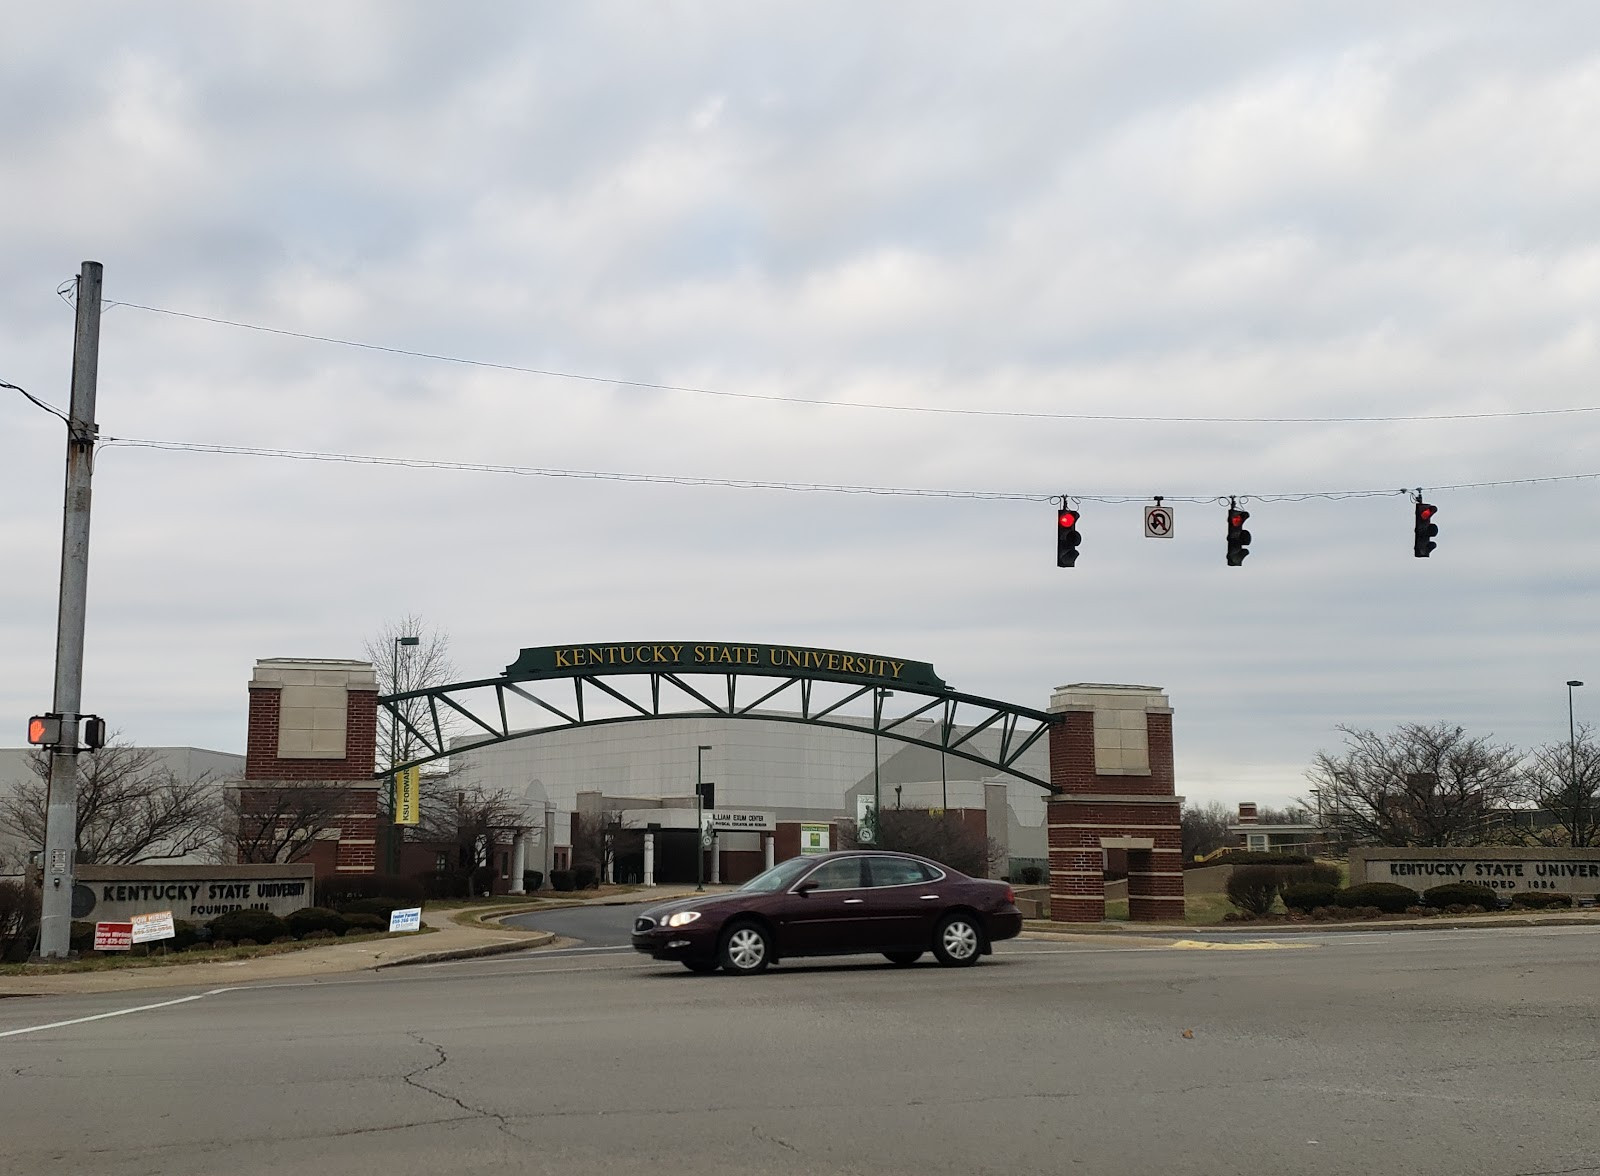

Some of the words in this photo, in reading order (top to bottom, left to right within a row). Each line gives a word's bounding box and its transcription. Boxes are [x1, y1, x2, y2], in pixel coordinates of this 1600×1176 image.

[554, 645, 684, 668] KENTUCKY
[694, 645, 760, 665] STATE
[768, 648, 905, 678] UNIVERSITY
[1390, 863, 1466, 876] KENTUCKY
[1475, 864, 1524, 877] STATE
[103, 885, 200, 902] KENTUCKY
[208, 885, 250, 900] STATE
[257, 882, 306, 899] UNIVERSITY
[148, 912, 172, 922] HIRING
